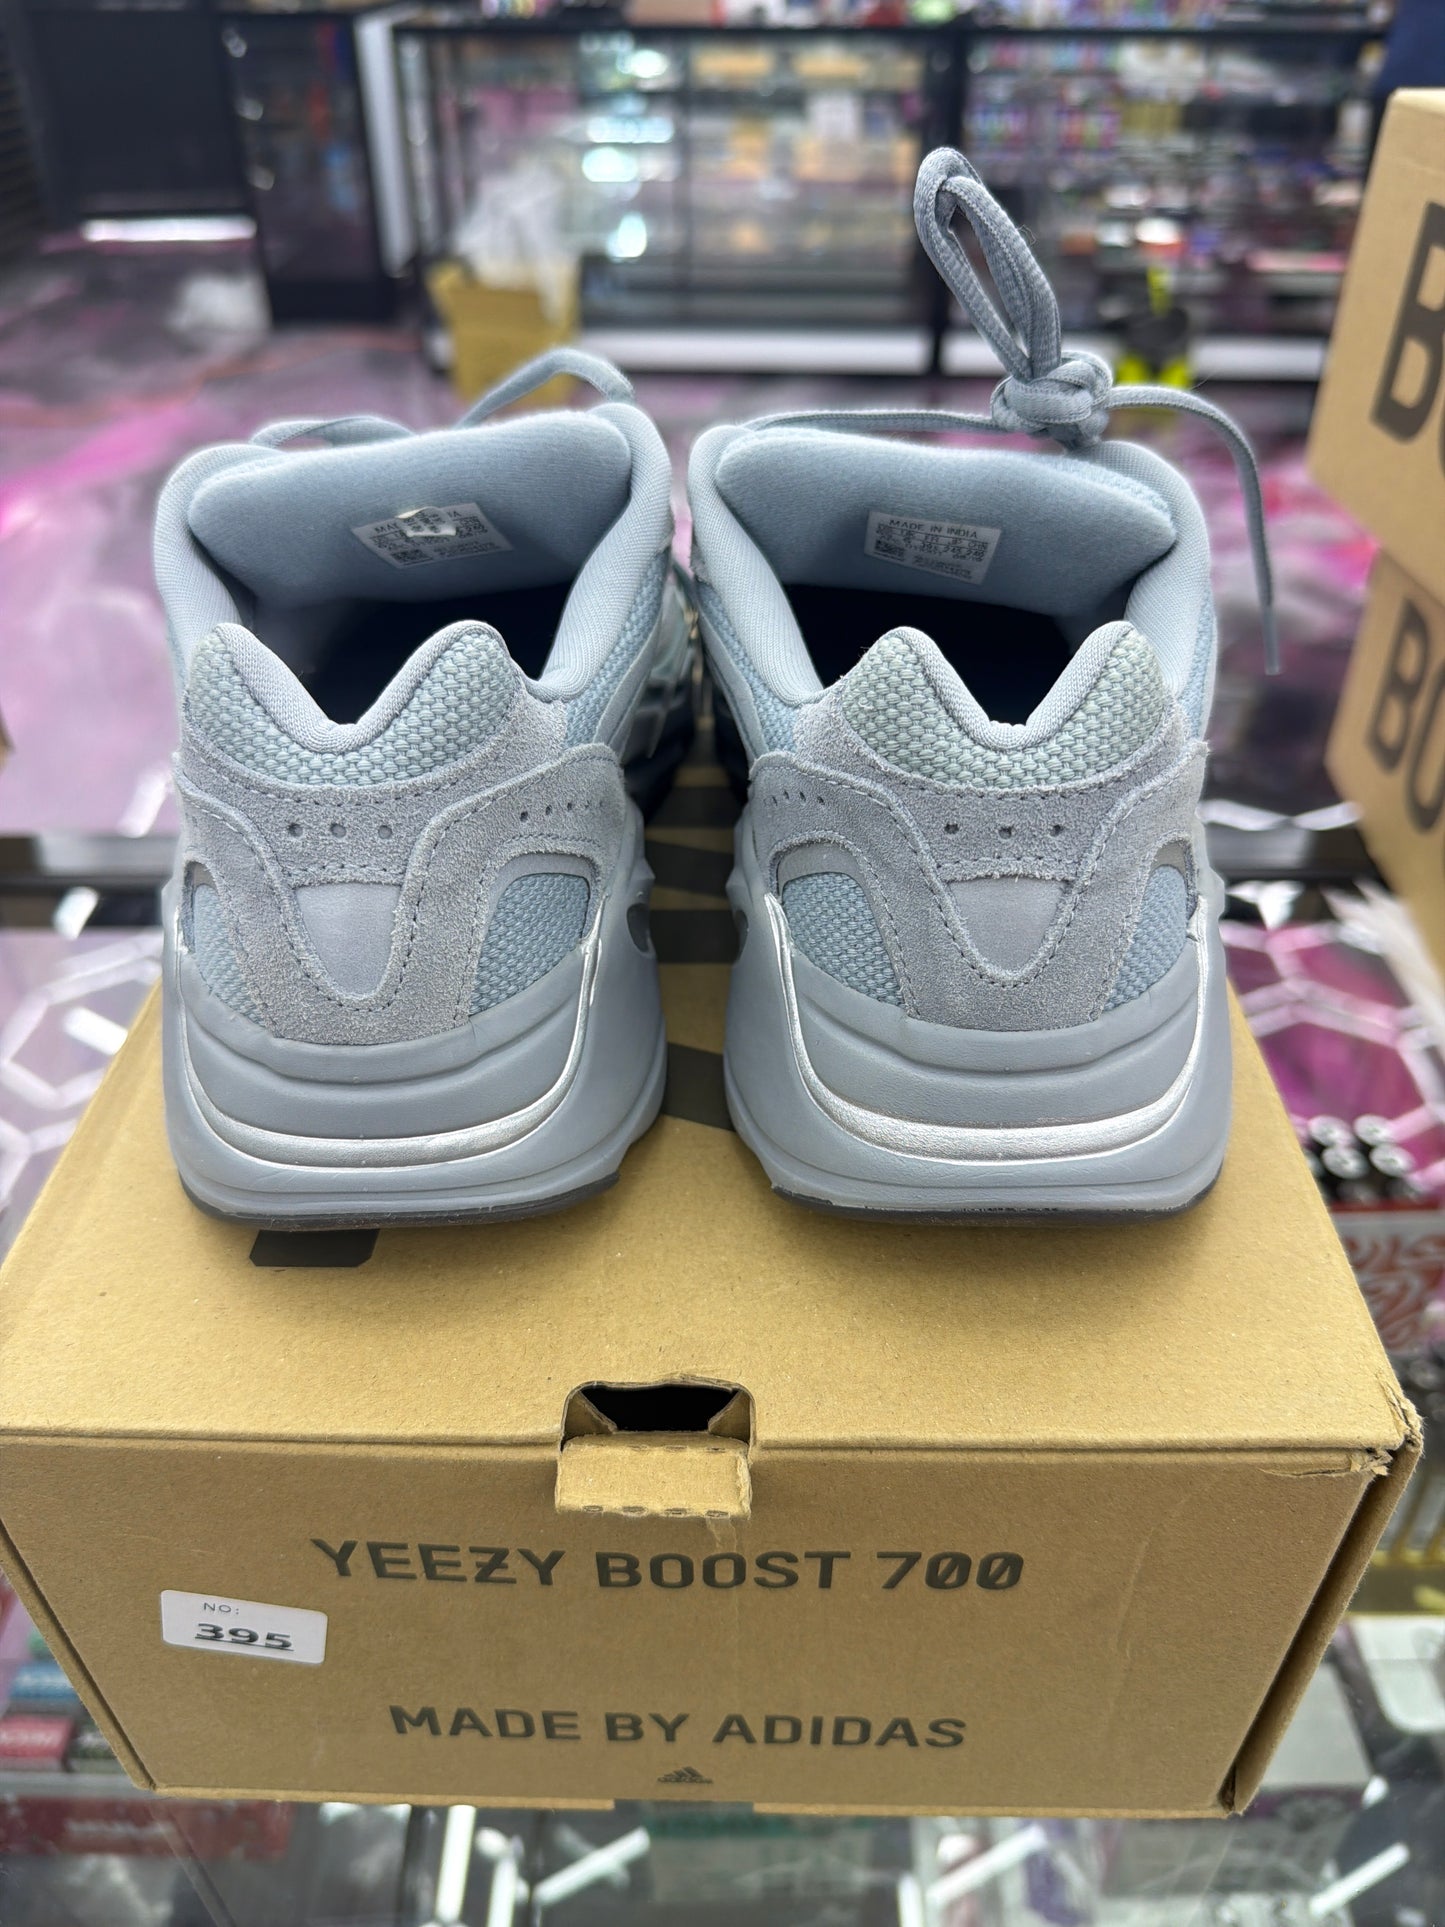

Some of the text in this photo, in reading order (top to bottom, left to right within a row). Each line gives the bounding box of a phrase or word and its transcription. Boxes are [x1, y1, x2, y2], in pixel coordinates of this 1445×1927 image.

[889, 520, 924, 532] MADE
[930, 525, 942, 534] IN
[947, 526, 978, 539] INDIA
[310, 1538, 1024, 1590] YEEZY BOOST 700
[203, 1602, 239, 1615] NO:
[195, 1622, 294, 1651] 395
[390, 1705, 966, 1748] MADE BY ADIDAS
